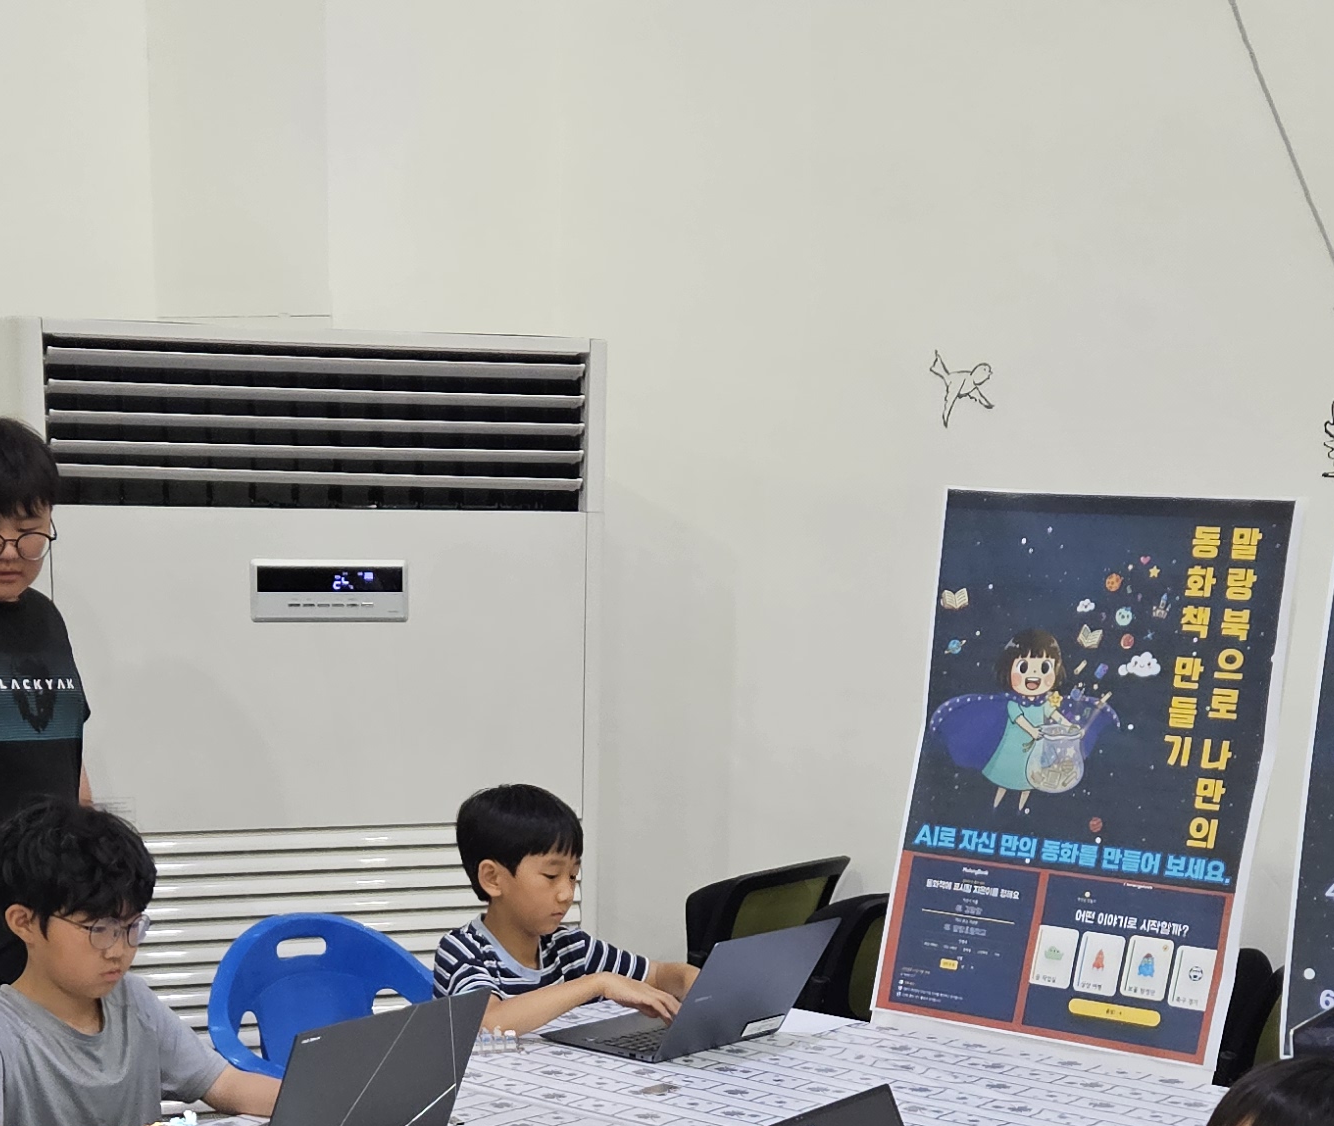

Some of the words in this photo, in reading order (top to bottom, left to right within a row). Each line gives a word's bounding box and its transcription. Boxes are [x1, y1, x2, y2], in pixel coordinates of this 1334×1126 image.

[1180, 526, 1221, 639] 동화책
[1207, 526, 1263, 721] 말랑북으로
[1164, 657, 1204, 767] 만들기
[1186, 738, 1232, 850] 나만의
[914, 825, 956, 849] AI로
[958, 832, 996, 853] 자신
[1000, 834, 1038, 859] 만의
[1041, 839, 1099, 867] 동화를
[1103, 848, 1160, 875] 만들어
[1165, 854, 1231, 885] 보세요.
[1075, 909, 1096, 924] 어떤
[1097, 912, 1137, 930] 이야기로
[1140, 920, 1190, 938] 시작할까?
